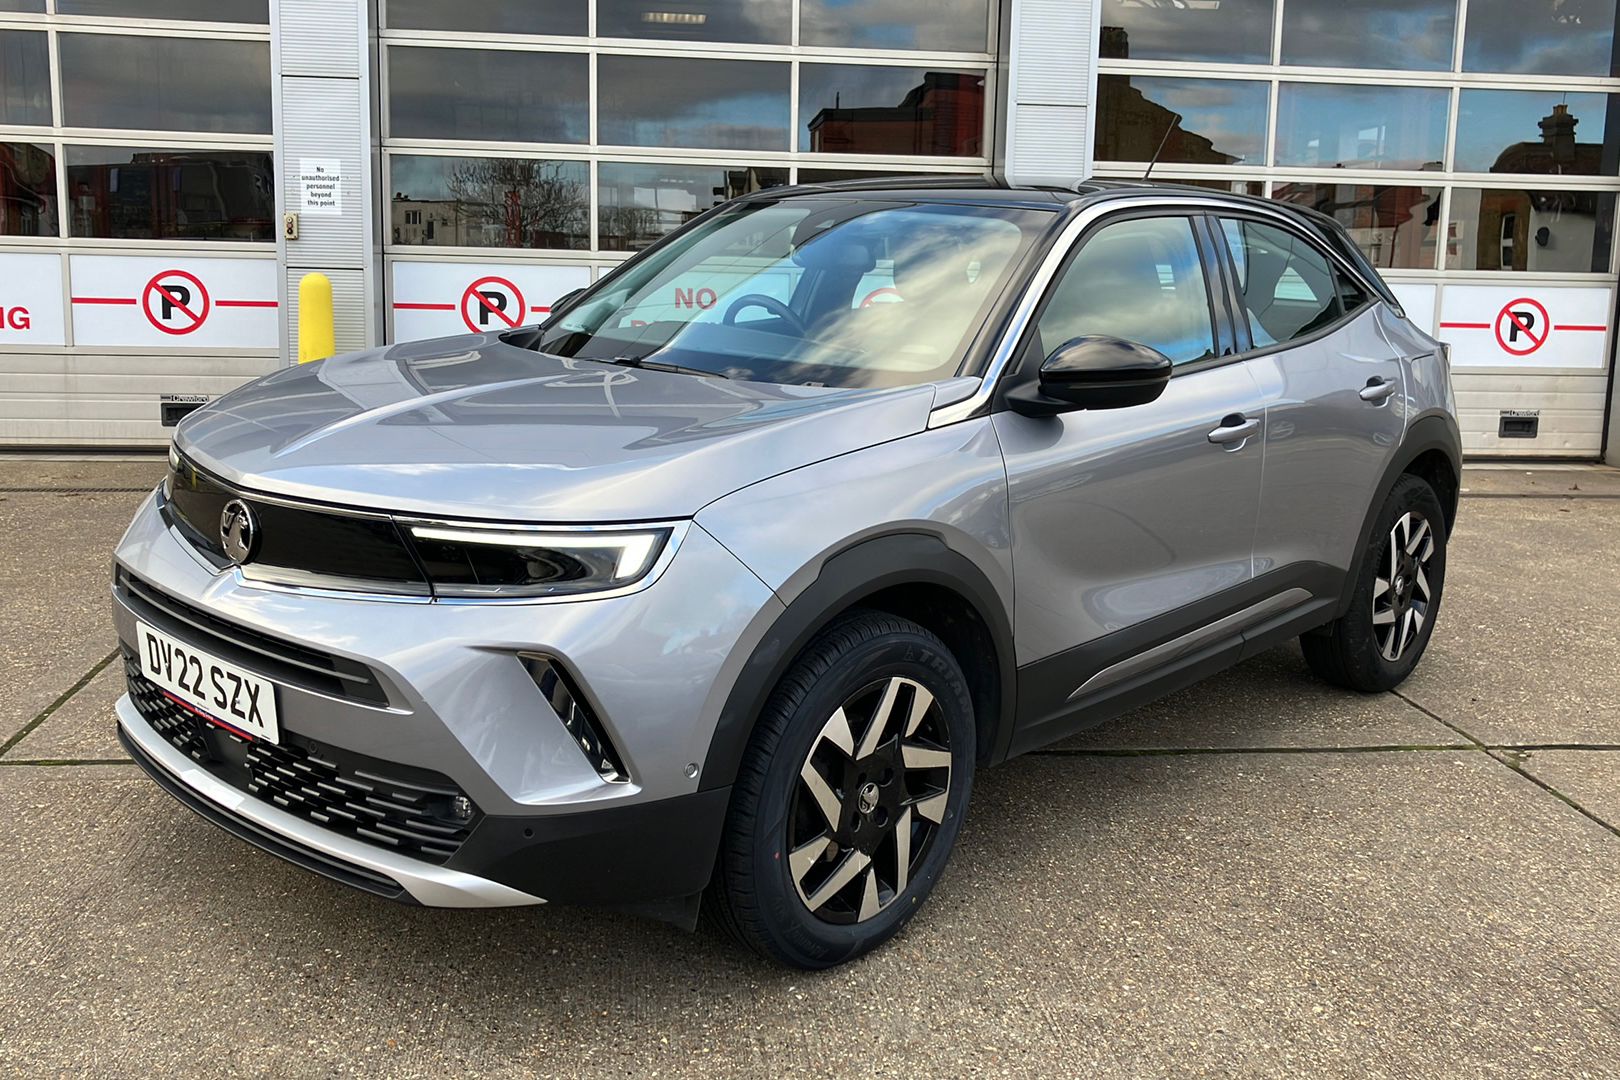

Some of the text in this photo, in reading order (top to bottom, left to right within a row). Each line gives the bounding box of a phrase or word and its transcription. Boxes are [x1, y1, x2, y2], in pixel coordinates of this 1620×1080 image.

[674, 287, 717, 310] NO
[0, 306, 30, 330] G
[146, 632, 264, 729] DV22 SZX
